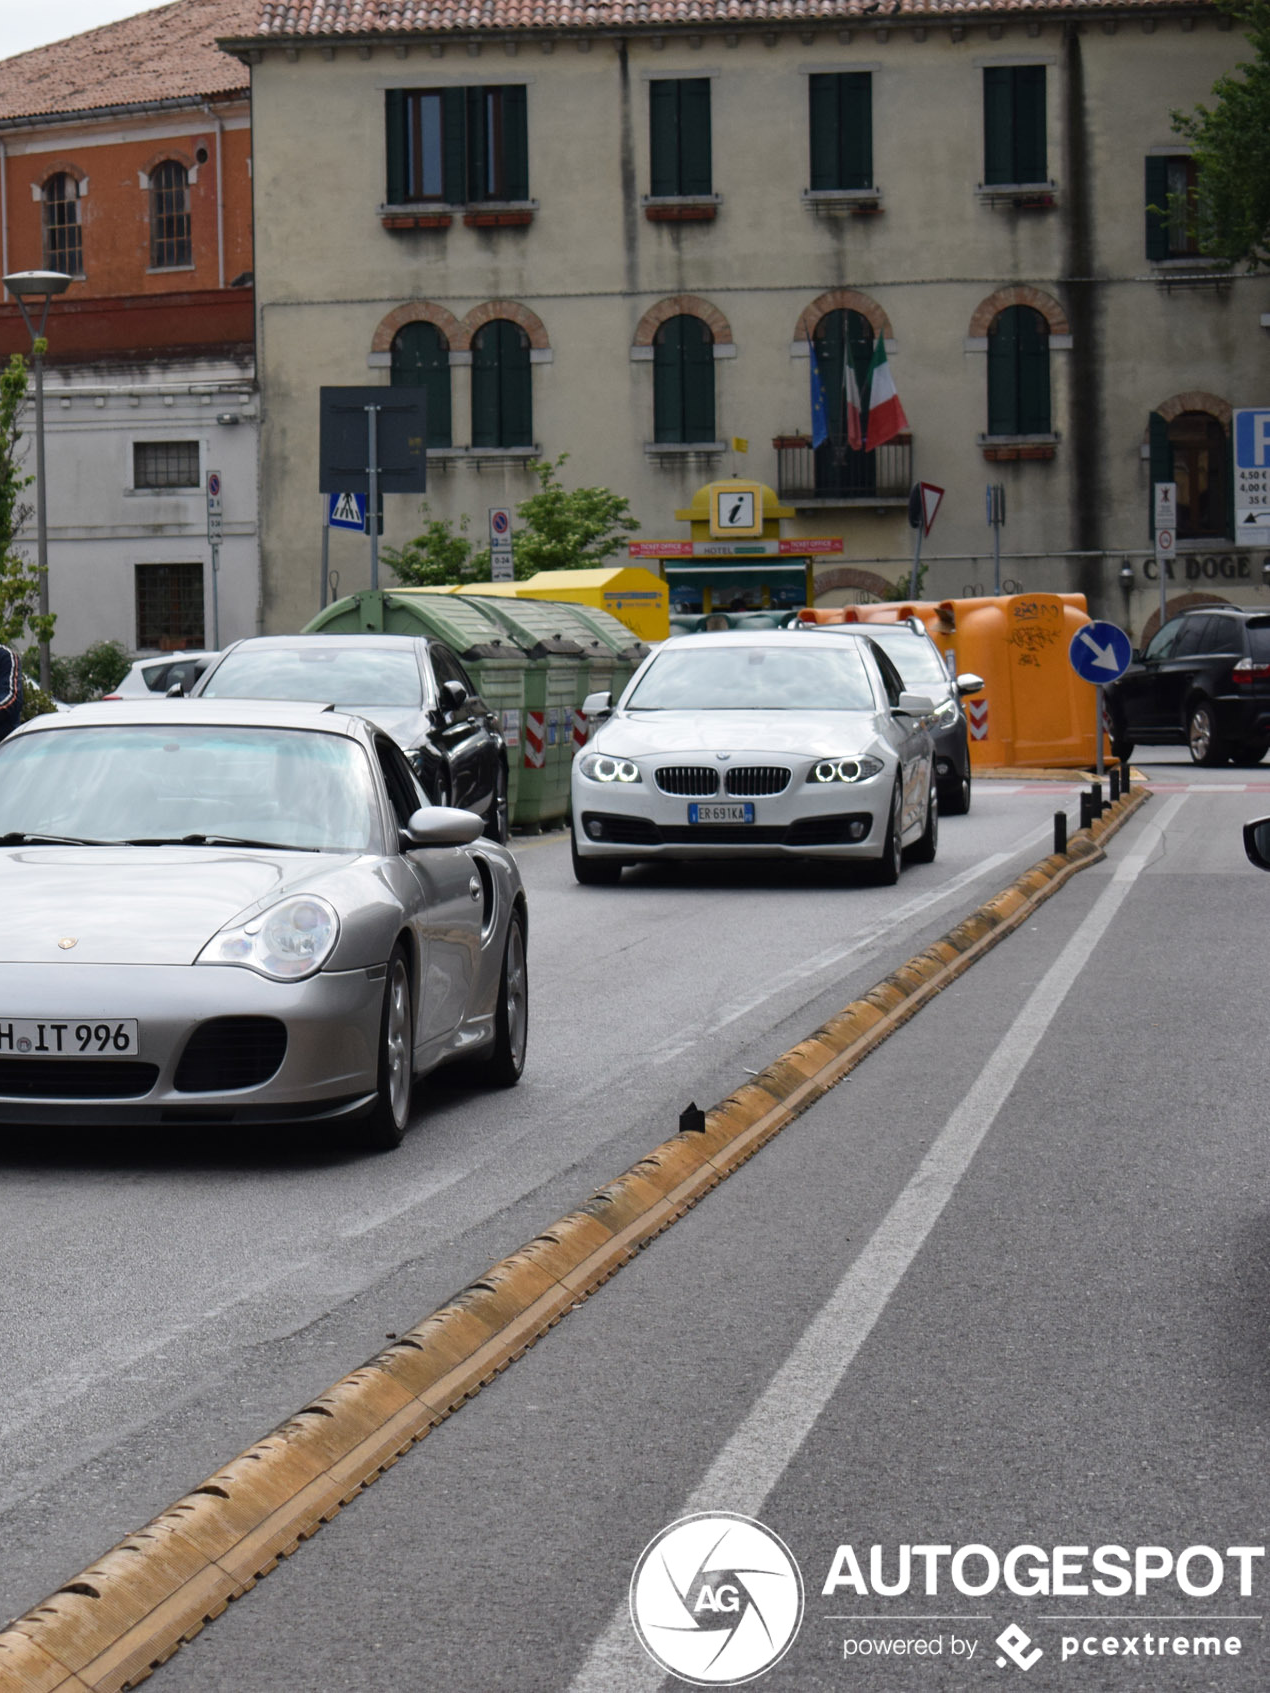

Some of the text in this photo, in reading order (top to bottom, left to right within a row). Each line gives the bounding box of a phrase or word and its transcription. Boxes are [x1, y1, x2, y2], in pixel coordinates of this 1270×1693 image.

[1240, 471, 1259, 480] 4,50
[1240, 483, 1259, 492] 4,00
[1248, 496, 1259, 505] 35
[1185, 556, 1250, 580] DOGE
[698, 808, 710, 819] ER
[34, 1024, 68, 1051] IT
[75, 1024, 130, 1051] 996
